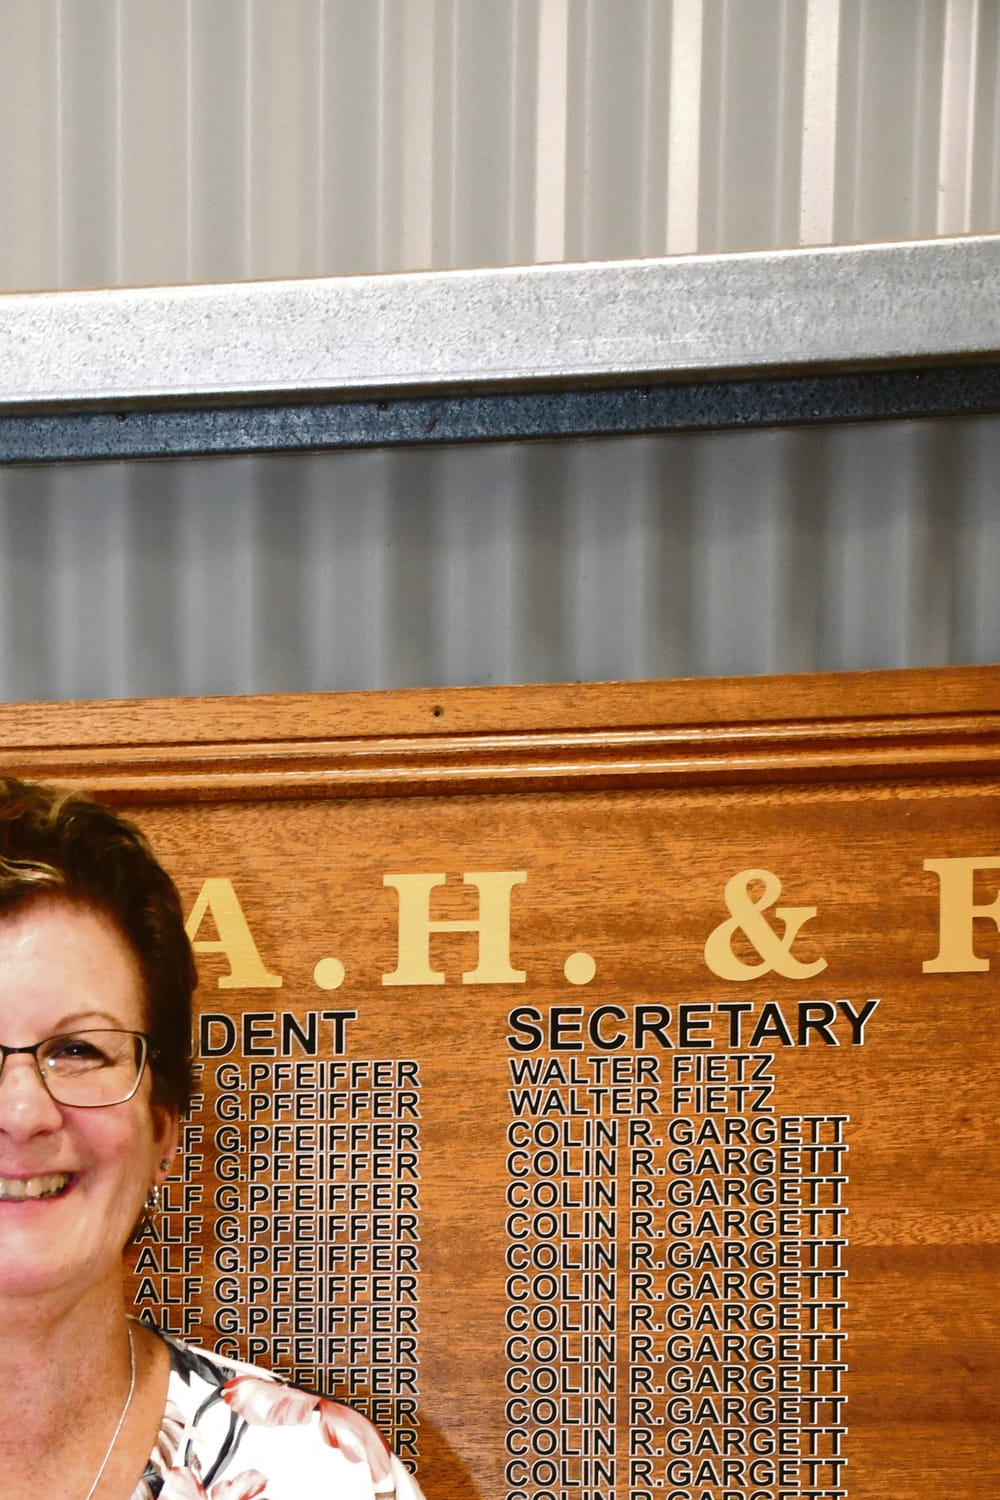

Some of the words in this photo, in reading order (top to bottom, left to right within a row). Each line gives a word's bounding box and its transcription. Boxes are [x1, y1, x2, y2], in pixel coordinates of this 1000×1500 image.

[704, 868, 828, 982] &
[506, 998, 880, 1053] SECRETARY
[214, 1060, 421, 1091] G.PFEIFFER
[509, 1056, 661, 1086] WALTER
[671, 1053, 776, 1084] FIETZ
[214, 1091, 421, 1122] G.PFEIFFER
[509, 1086, 661, 1117] WALTER
[671, 1084, 775, 1115] FIETZ
[214, 1122, 421, 1153] G.PFEIFFER
[214, 1153, 421, 1183] G.PFEIFFER
[507, 1148, 617, 1177] COLIN
[629, 1146, 848, 1176] R.GARGETT
[214, 1183, 421, 1213] G.PFEIFFER
[214, 1213, 421, 1244] G.PFEIFFER
[507, 1210, 617, 1239] COLIN
[629, 1208, 848, 1238] R.GARGETT
[133, 1245, 203, 1274] ALF
[214, 1244, 421, 1274] G.PFEIFFER
[133, 1275, 203, 1305] ALF
[214, 1274, 421, 1304] G.PFEIFFER
[507, 1272, 617, 1301] COLIN
[629, 1271, 848, 1300] R.GARGETT
[214, 1304, 421, 1335] G.PFEIFFER
[506, 1334, 617, 1363] COLIN
[629, 1333, 848, 1363] R.GARGETT
[506, 1427, 617, 1456] COLIN
[629, 1427, 848, 1457] R.GARGETT
[506, 1458, 617, 1487] COLIN
[629, 1458, 848, 1488] R.GARGETT
